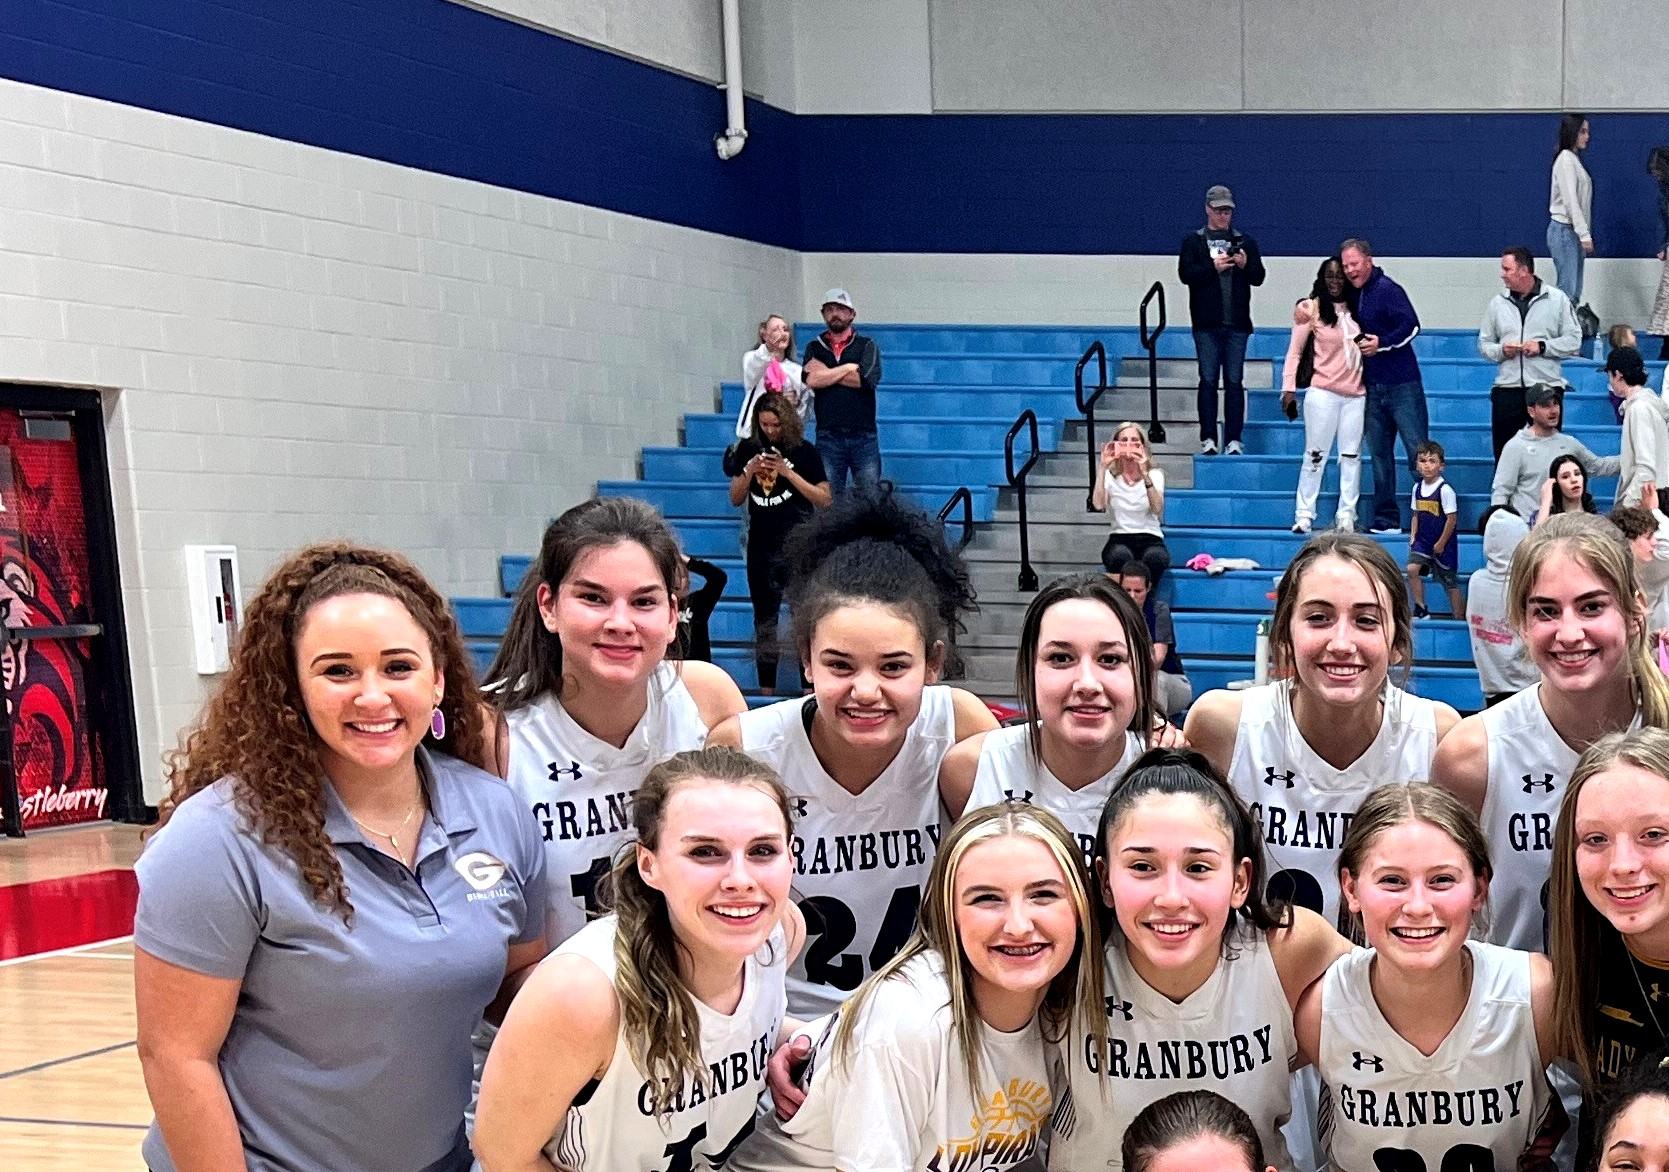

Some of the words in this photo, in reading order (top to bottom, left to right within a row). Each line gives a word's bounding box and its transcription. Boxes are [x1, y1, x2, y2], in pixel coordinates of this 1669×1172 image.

[19, 783, 109, 819] stleberry
[532, 790, 640, 842] GRAN
[1248, 801, 1350, 849] GRAN
[792, 824, 943, 876] RANBURY
[1085, 1024, 1272, 1080] GRANBURY
[1597, 1035, 1637, 1079] ADY
[1341, 1080, 1524, 1128] GRANBURY
